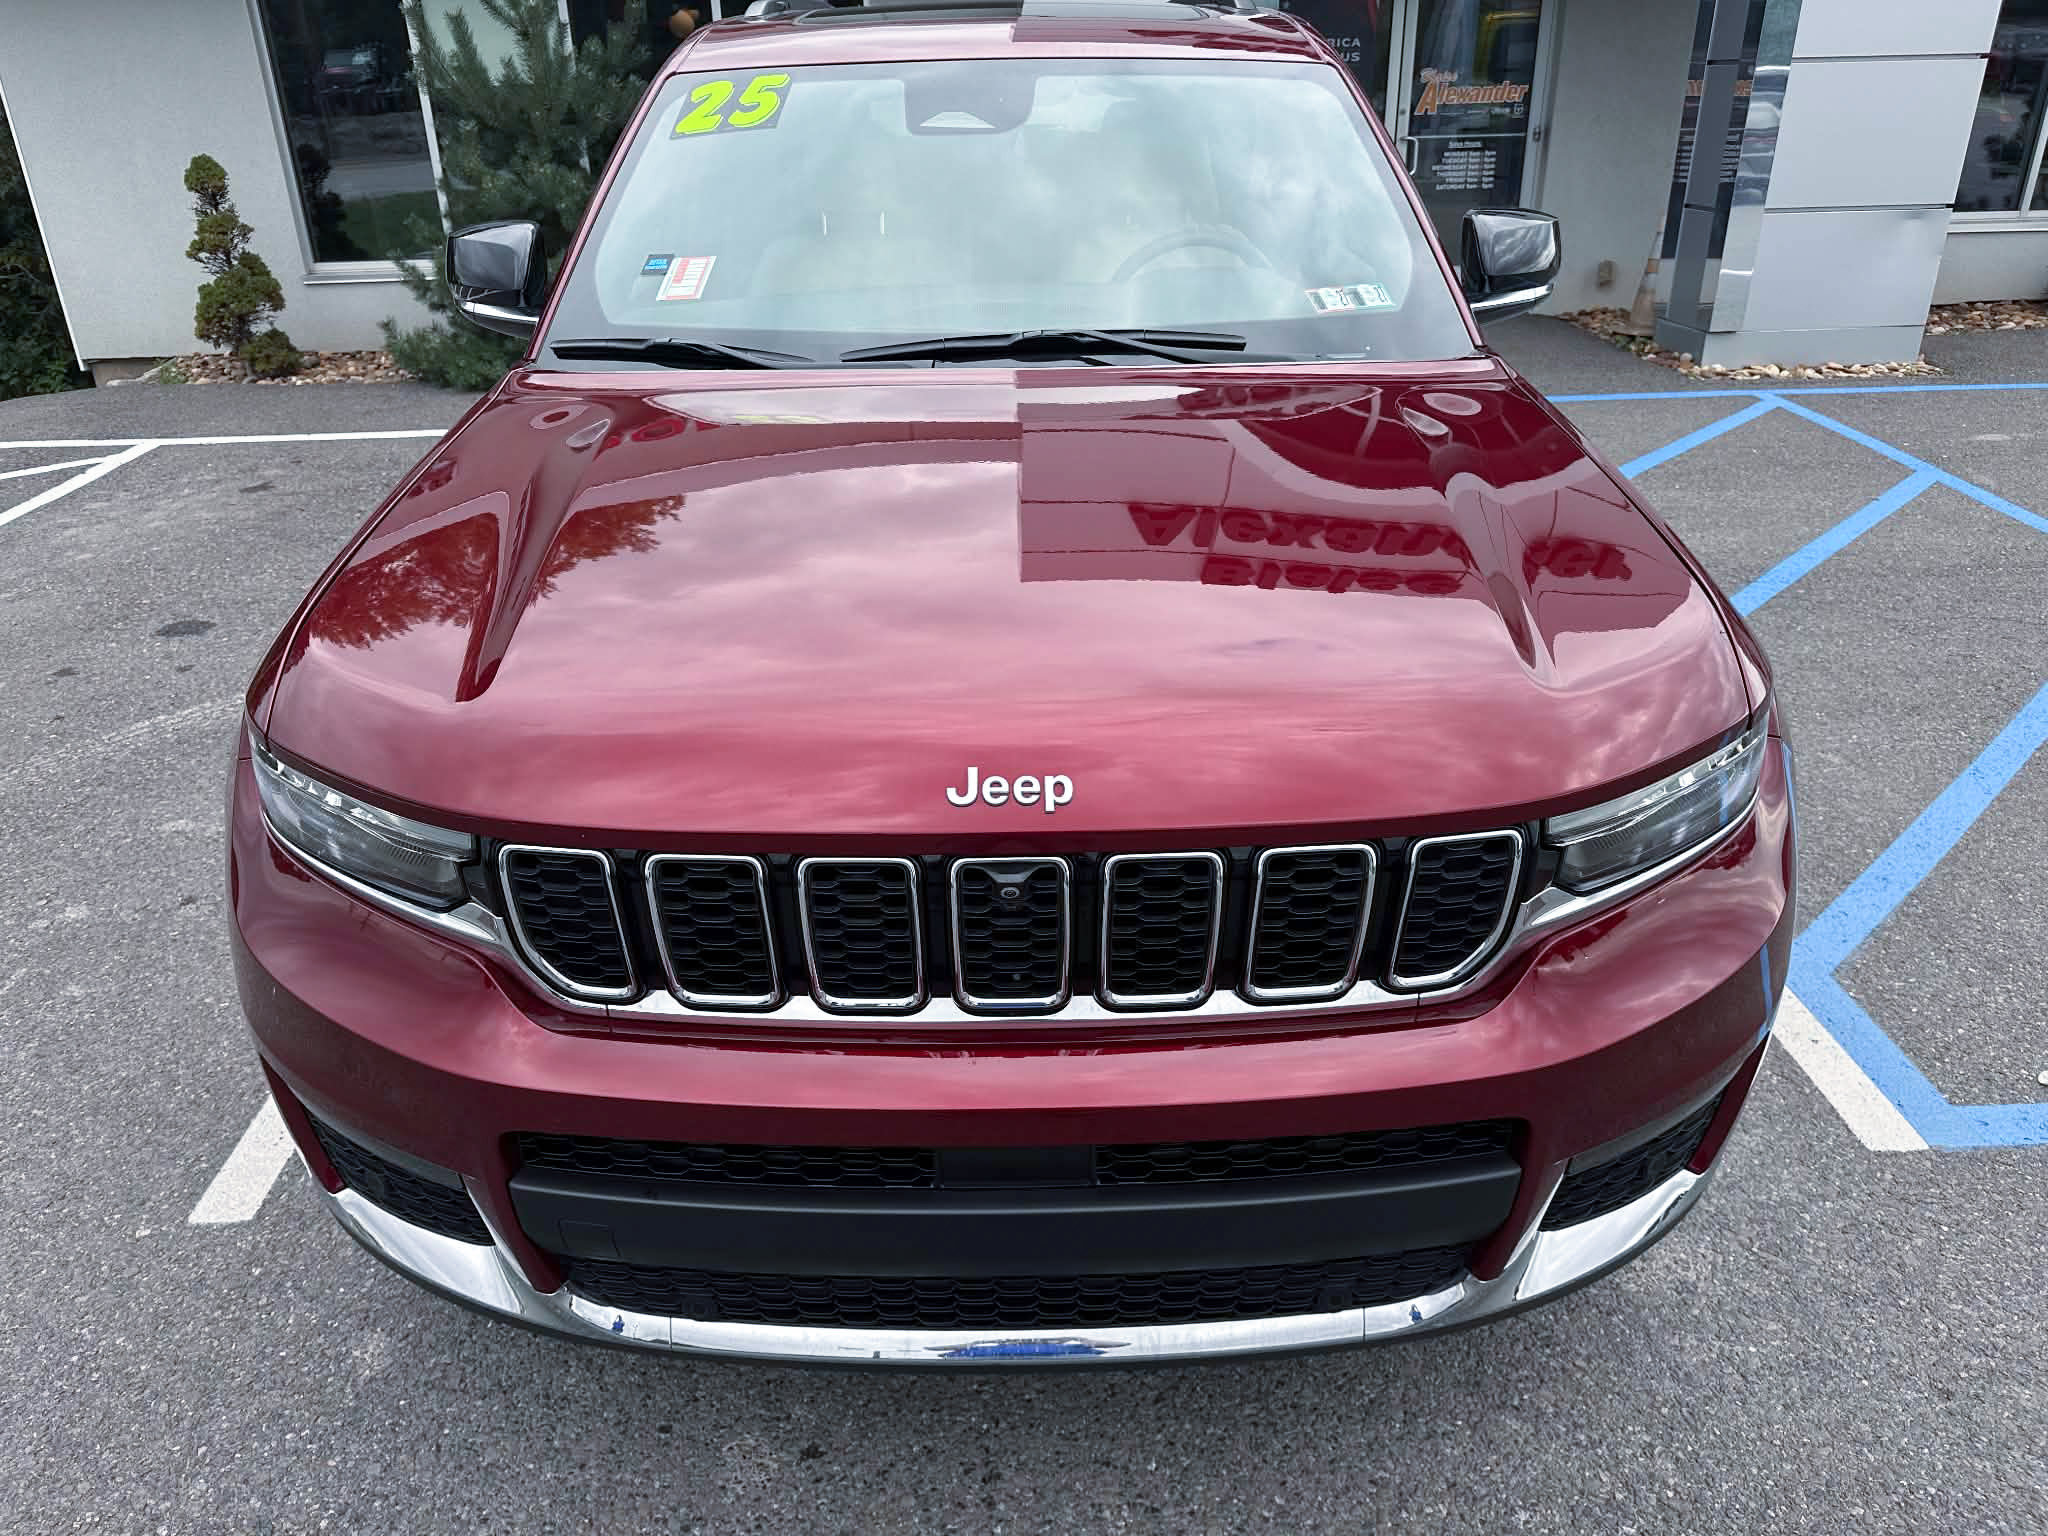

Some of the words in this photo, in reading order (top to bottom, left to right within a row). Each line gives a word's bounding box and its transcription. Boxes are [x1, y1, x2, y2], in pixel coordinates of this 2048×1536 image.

[675, 73, 791, 134] 25
[1414, 79, 1529, 116] Alexander
[946, 766, 1074, 814] Jeep
